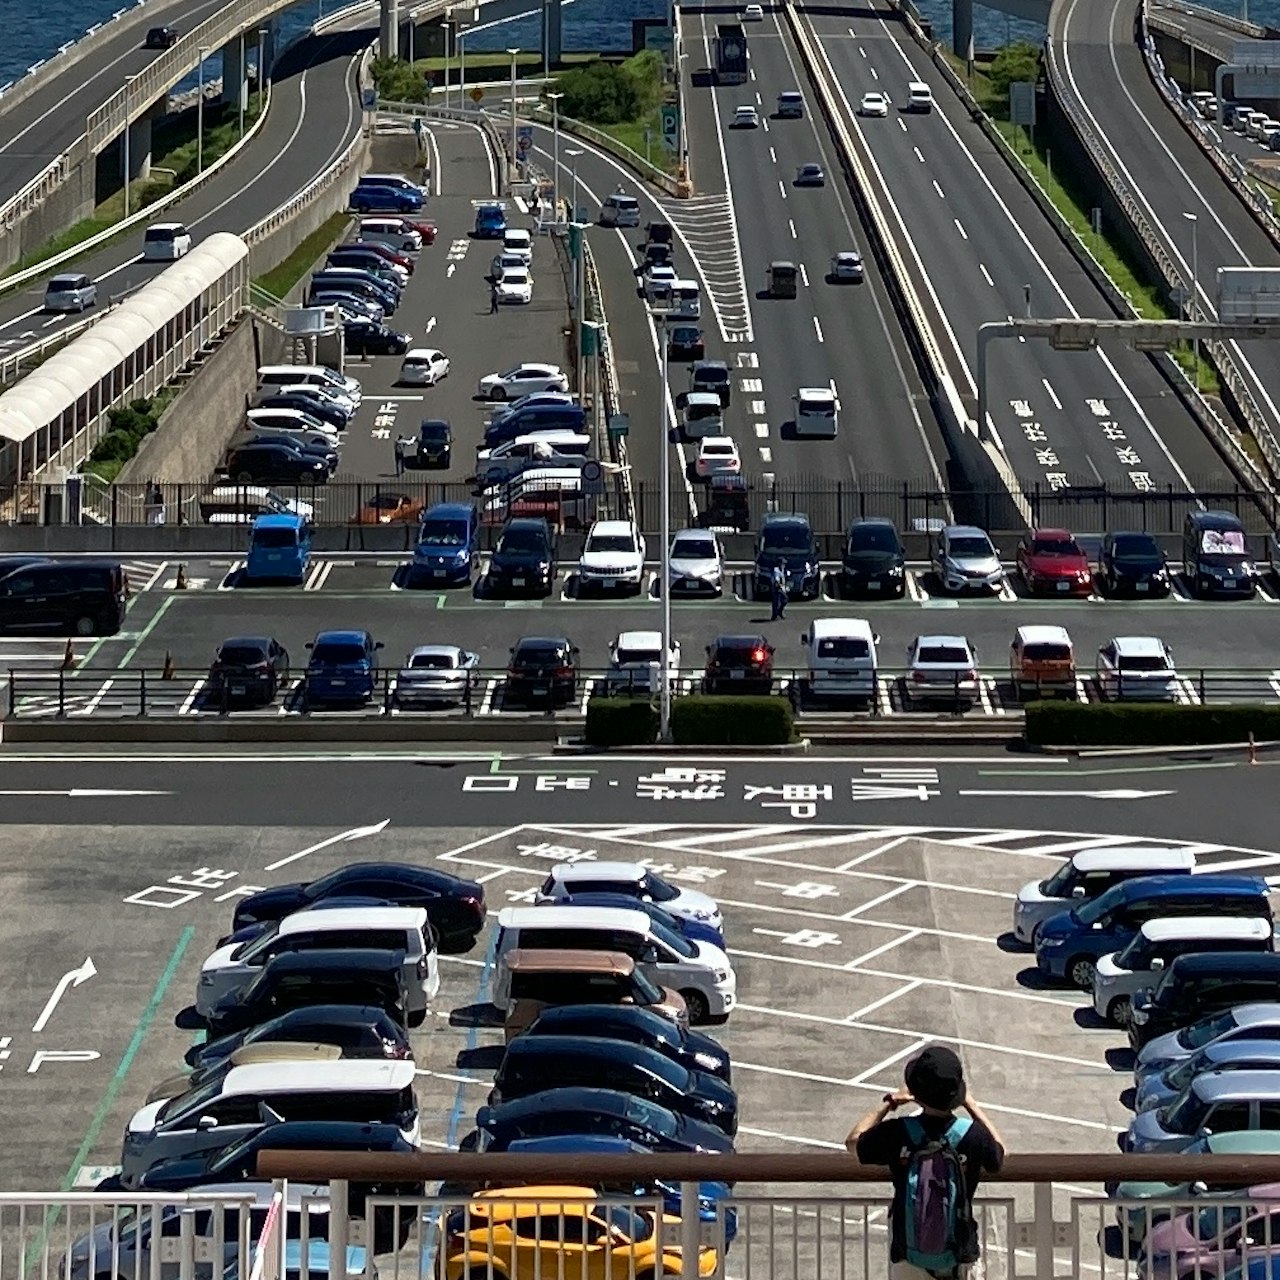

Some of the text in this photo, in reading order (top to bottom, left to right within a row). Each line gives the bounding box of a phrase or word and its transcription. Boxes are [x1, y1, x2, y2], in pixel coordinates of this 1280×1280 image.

[665, 116, 675, 132] P
[371, 402, 399, 439] 止まれ
[636, 782, 942, 801] 木更津
[761, 802, 817, 819] P
[123, 867, 239, 909] 出口
[27, 1050, 102, 1073] P
